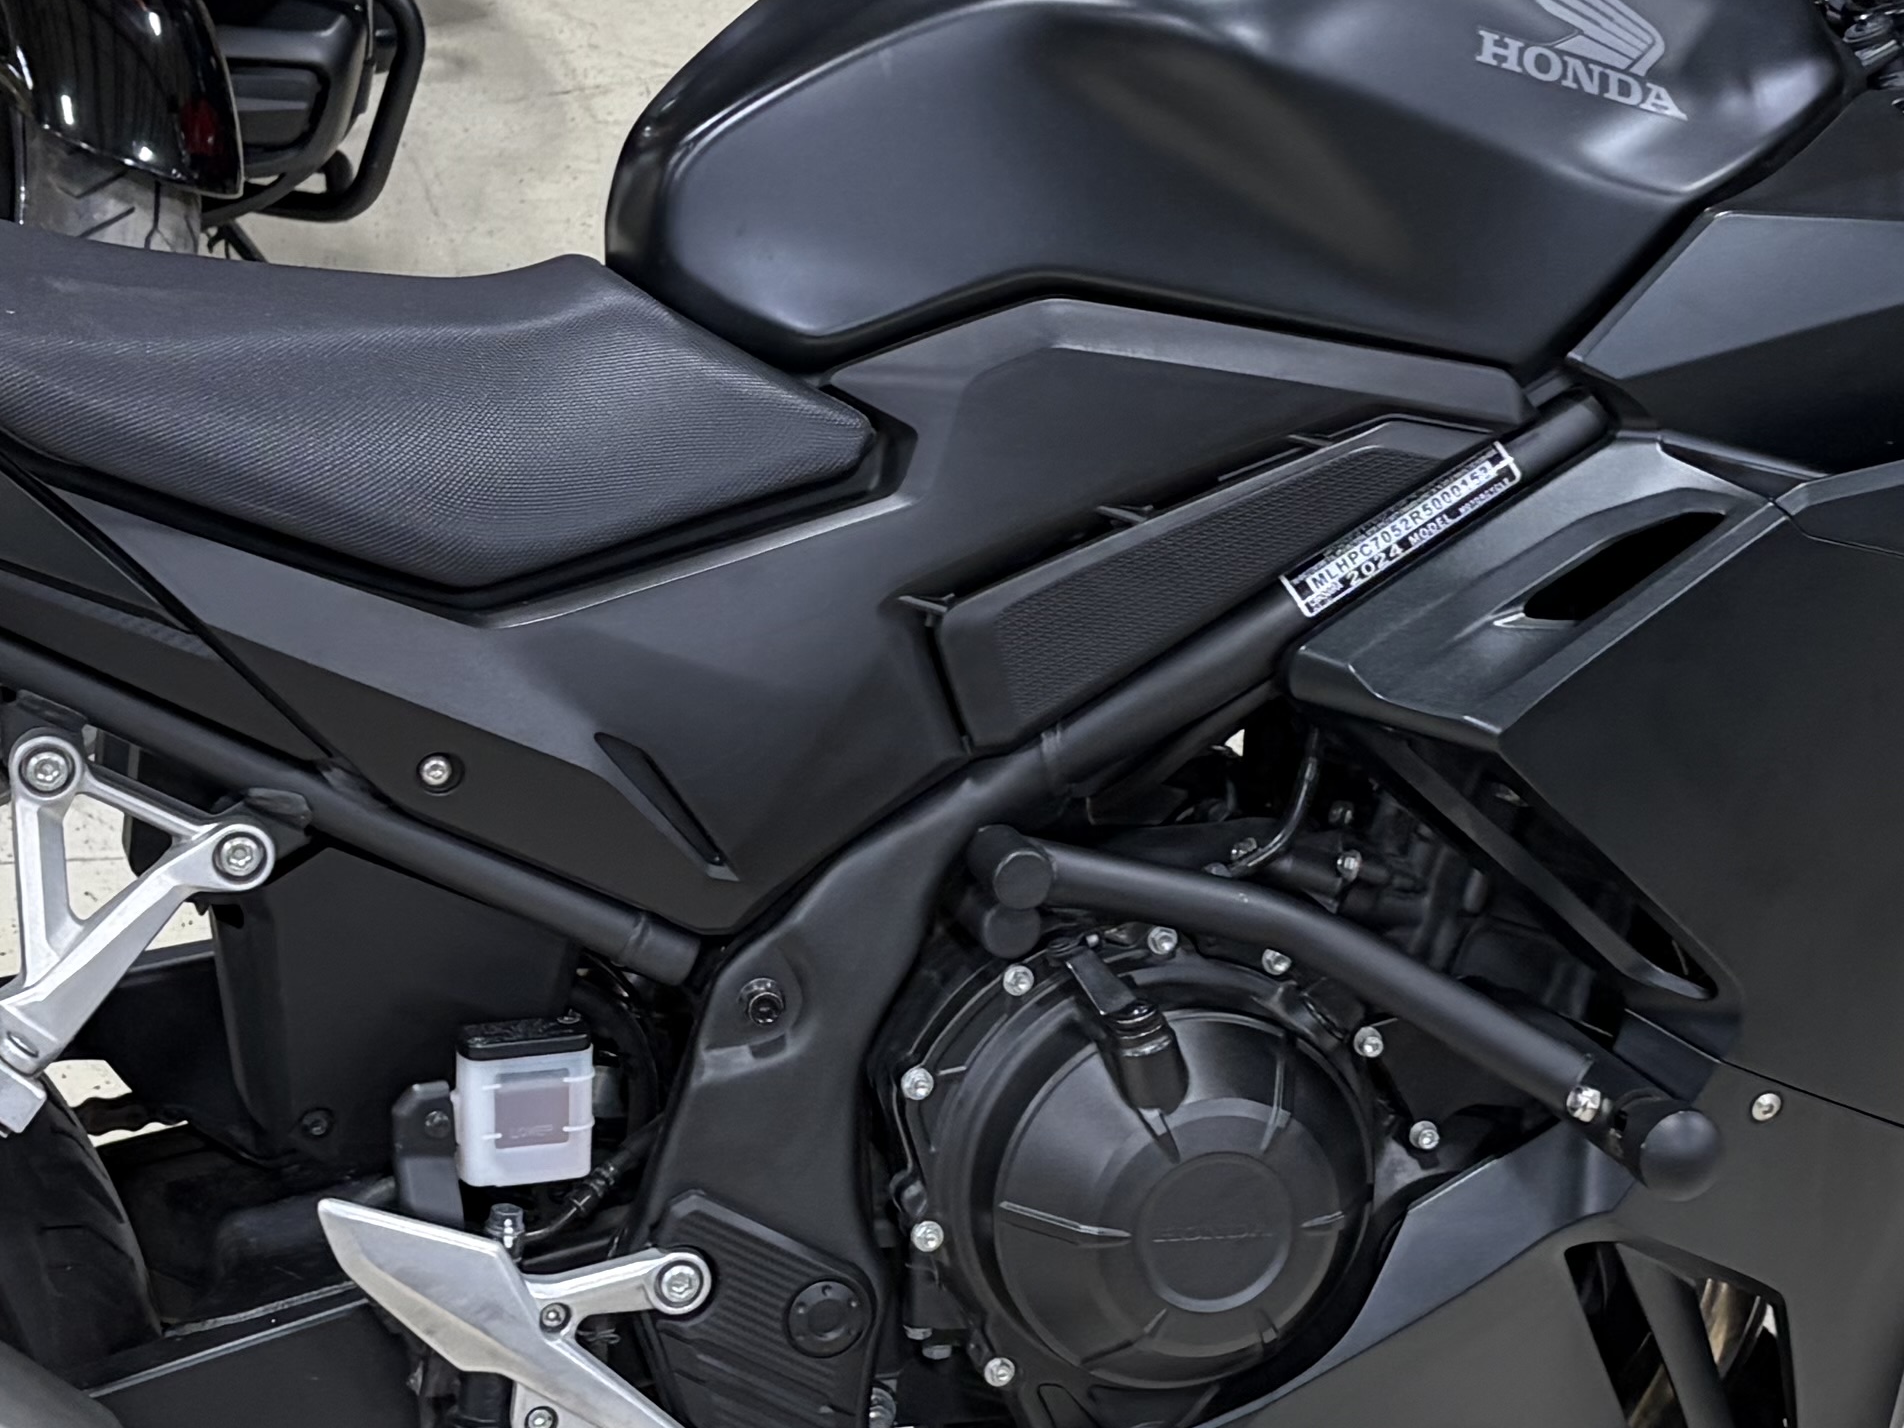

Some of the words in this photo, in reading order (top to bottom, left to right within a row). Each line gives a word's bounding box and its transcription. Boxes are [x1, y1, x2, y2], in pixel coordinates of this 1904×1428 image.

[1475, 29, 1689, 122] HONDA
[1346, 542, 1404, 589] 2024
[1407, 512, 1453, 547] MODEL
